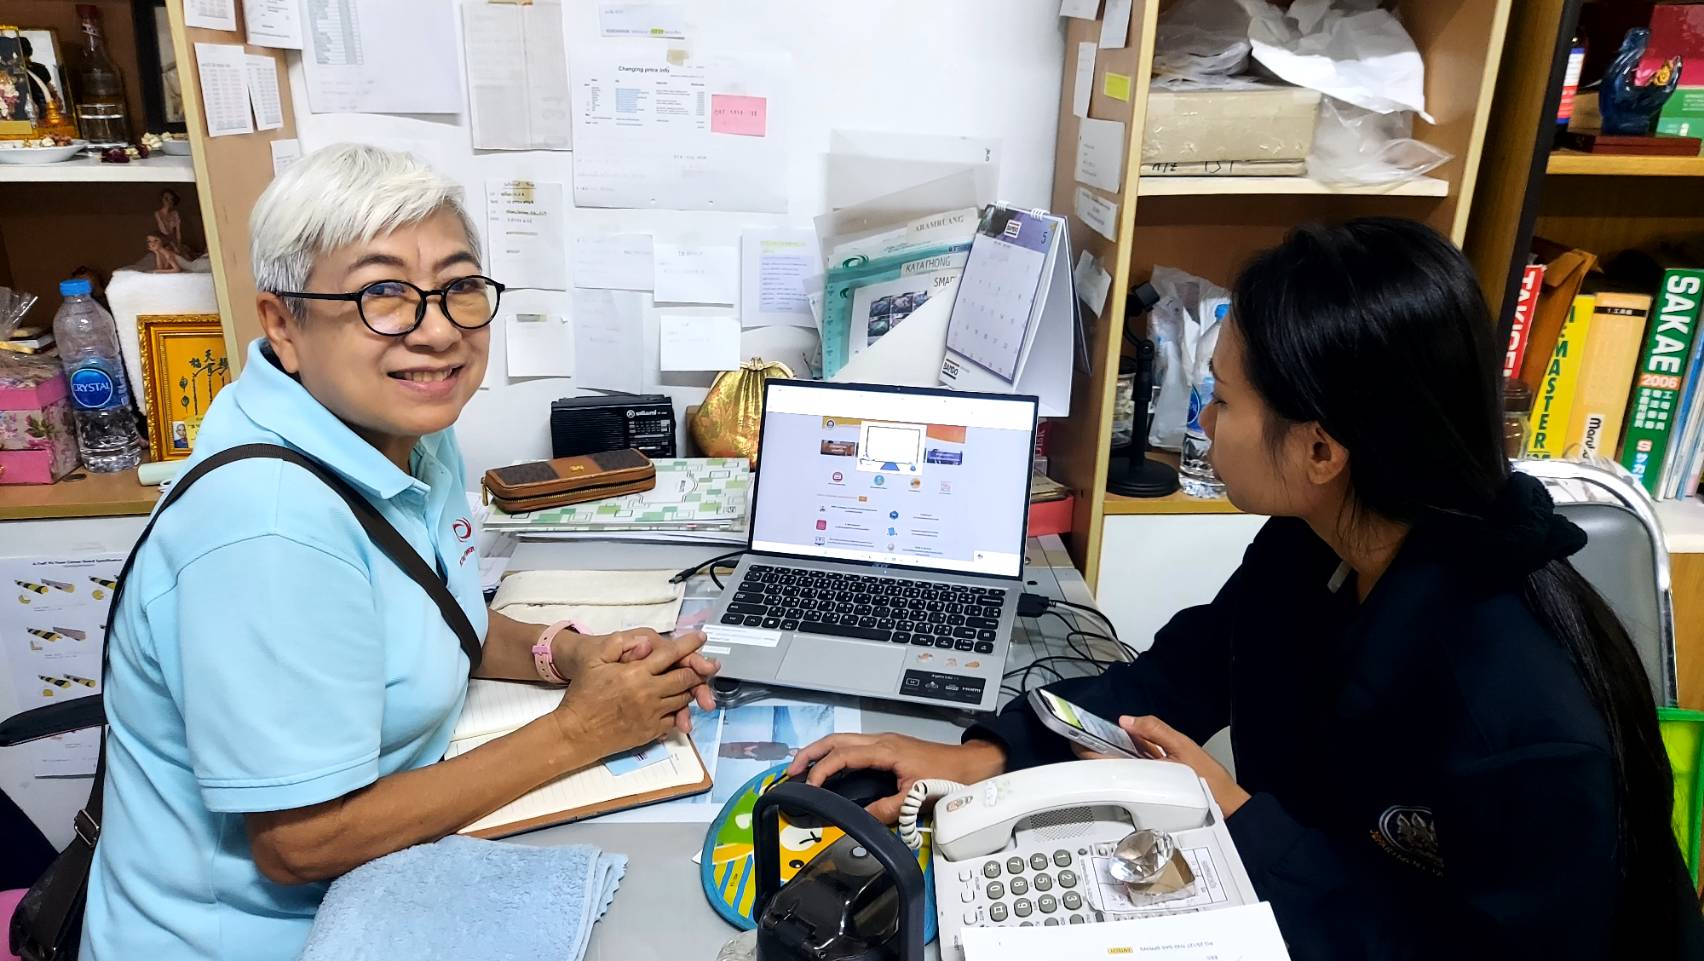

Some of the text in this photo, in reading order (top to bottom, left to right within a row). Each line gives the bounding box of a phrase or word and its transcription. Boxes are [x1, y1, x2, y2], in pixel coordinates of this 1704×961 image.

[1040, 231, 1048, 245] 5
[1648, 274, 1701, 374] SAKAE
[73, 382, 111, 392] CRYSTAL
[1641, 374, 1679, 389] 2006
[1533, 340, 1569, 449] MASTER
